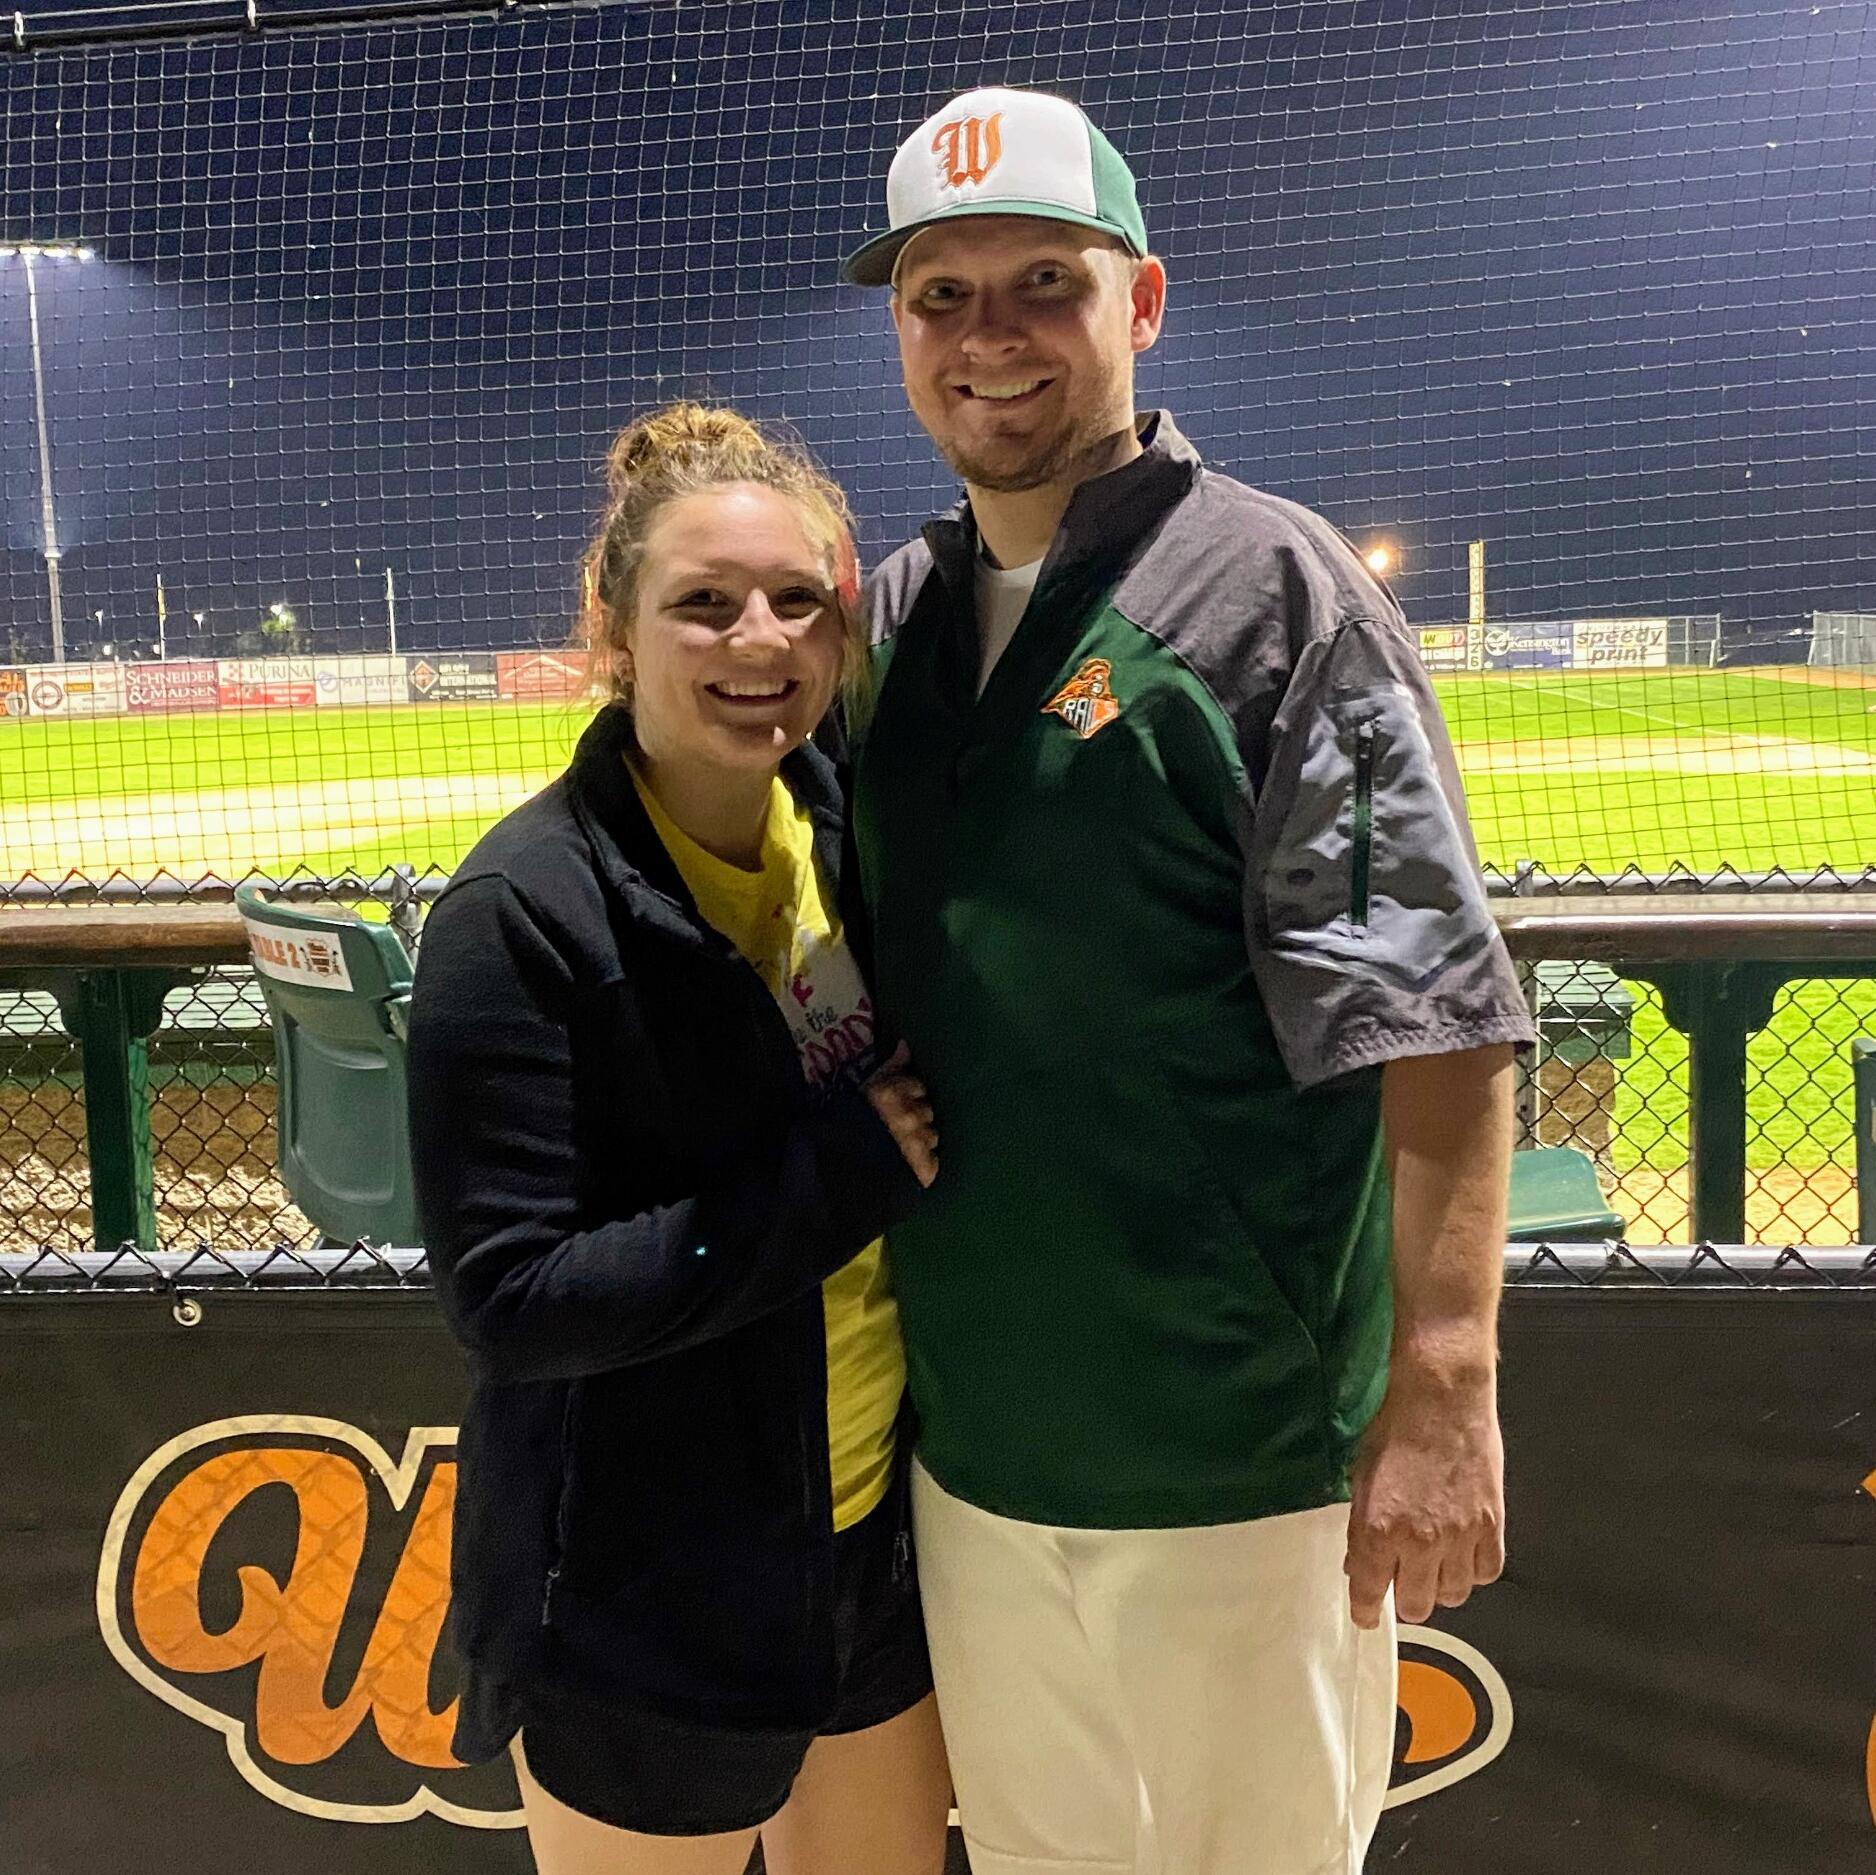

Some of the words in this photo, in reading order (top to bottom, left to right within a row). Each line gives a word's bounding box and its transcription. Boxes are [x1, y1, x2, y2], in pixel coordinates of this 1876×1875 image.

[931, 112, 1002, 188] W
[1577, 626, 1664, 648] speedy
[1591, 645, 1649, 664] print
[126, 670, 217, 685] SCHNEIDER
[249, 662, 311, 680] PURINA
[129, 686, 149, 705] &
[151, 685, 217, 700] MADSEN
